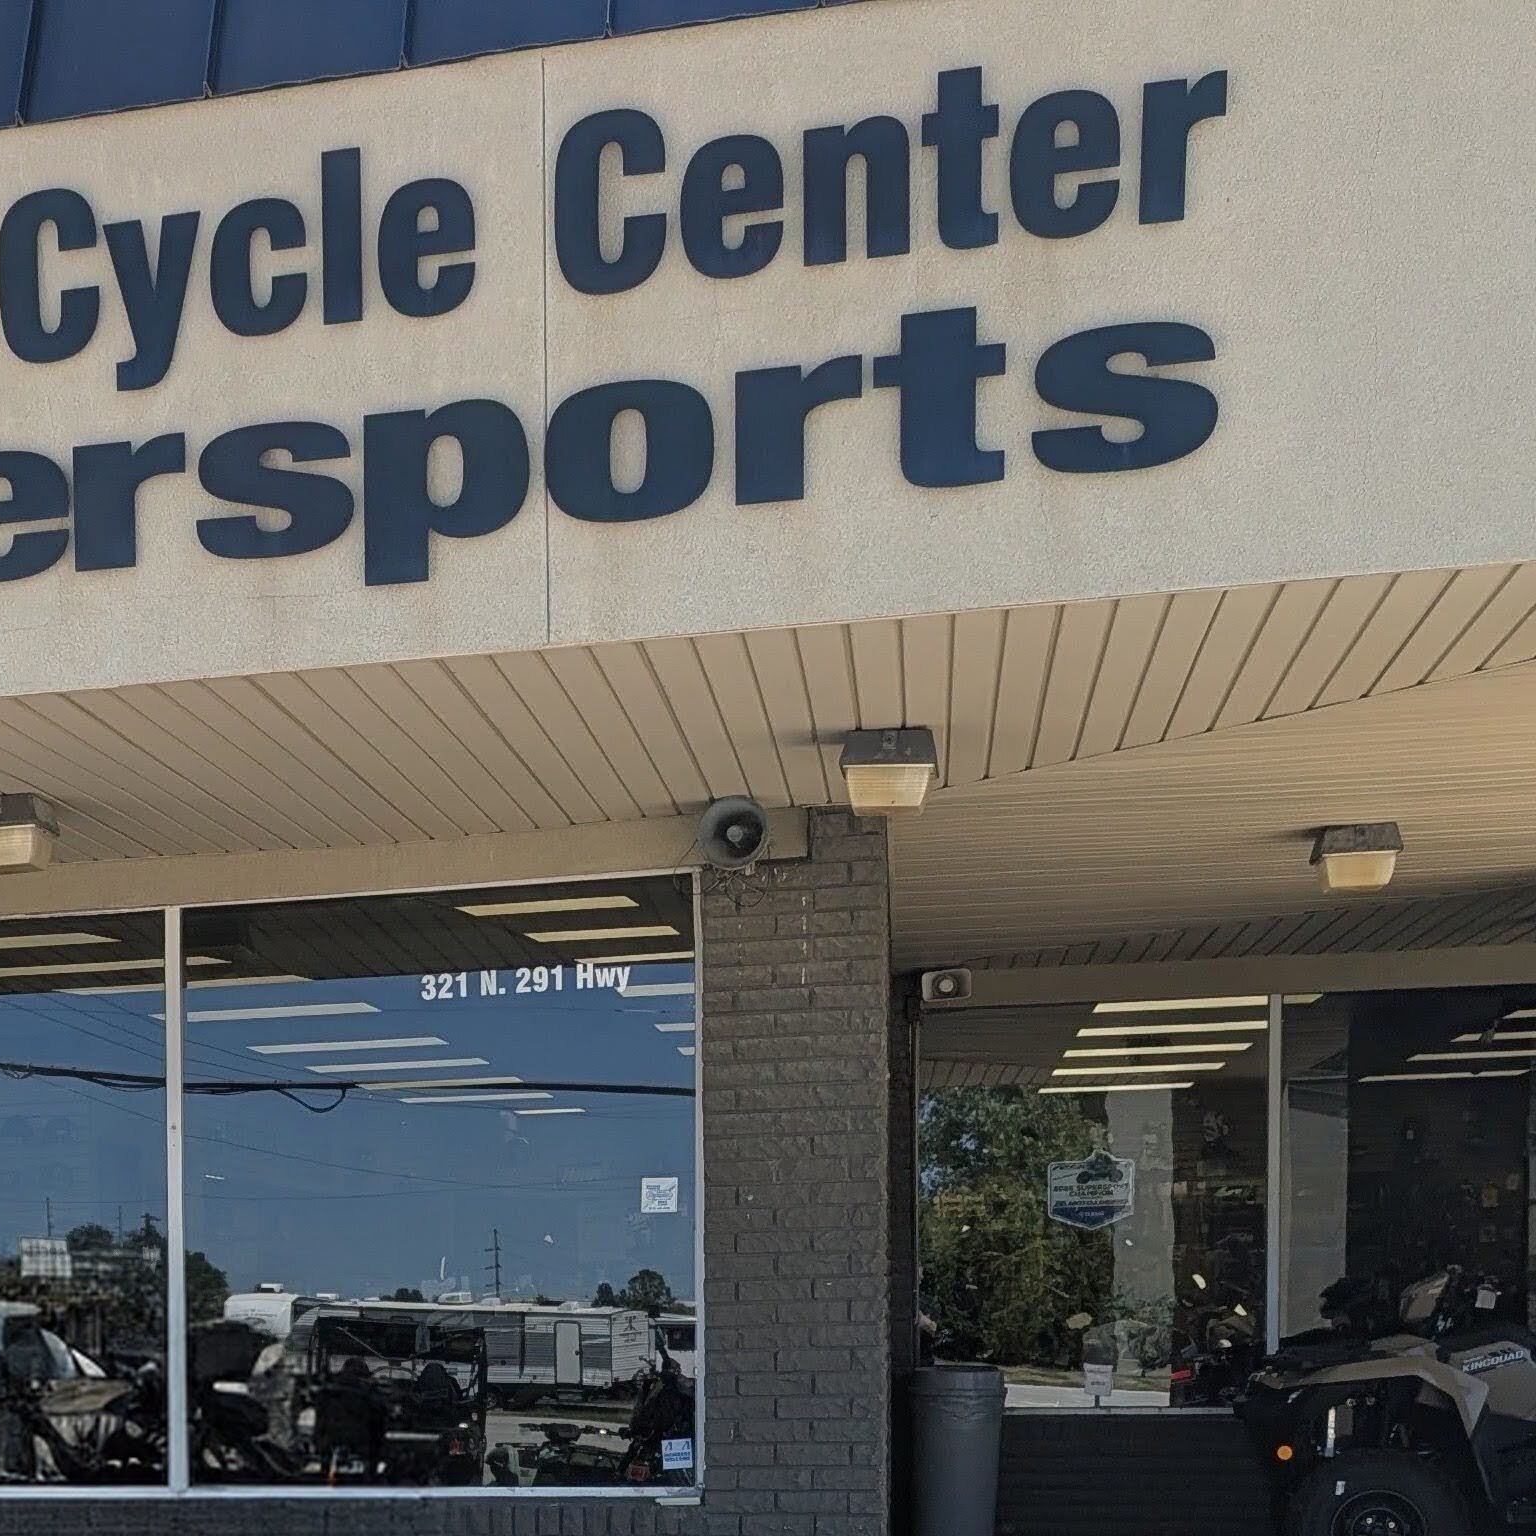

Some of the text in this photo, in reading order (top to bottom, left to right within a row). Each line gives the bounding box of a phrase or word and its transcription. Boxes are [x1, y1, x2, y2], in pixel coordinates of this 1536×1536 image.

[554, 65, 1228, 296] Center
[420, 963, 632, 1000] 321 N. 291 Hwy
